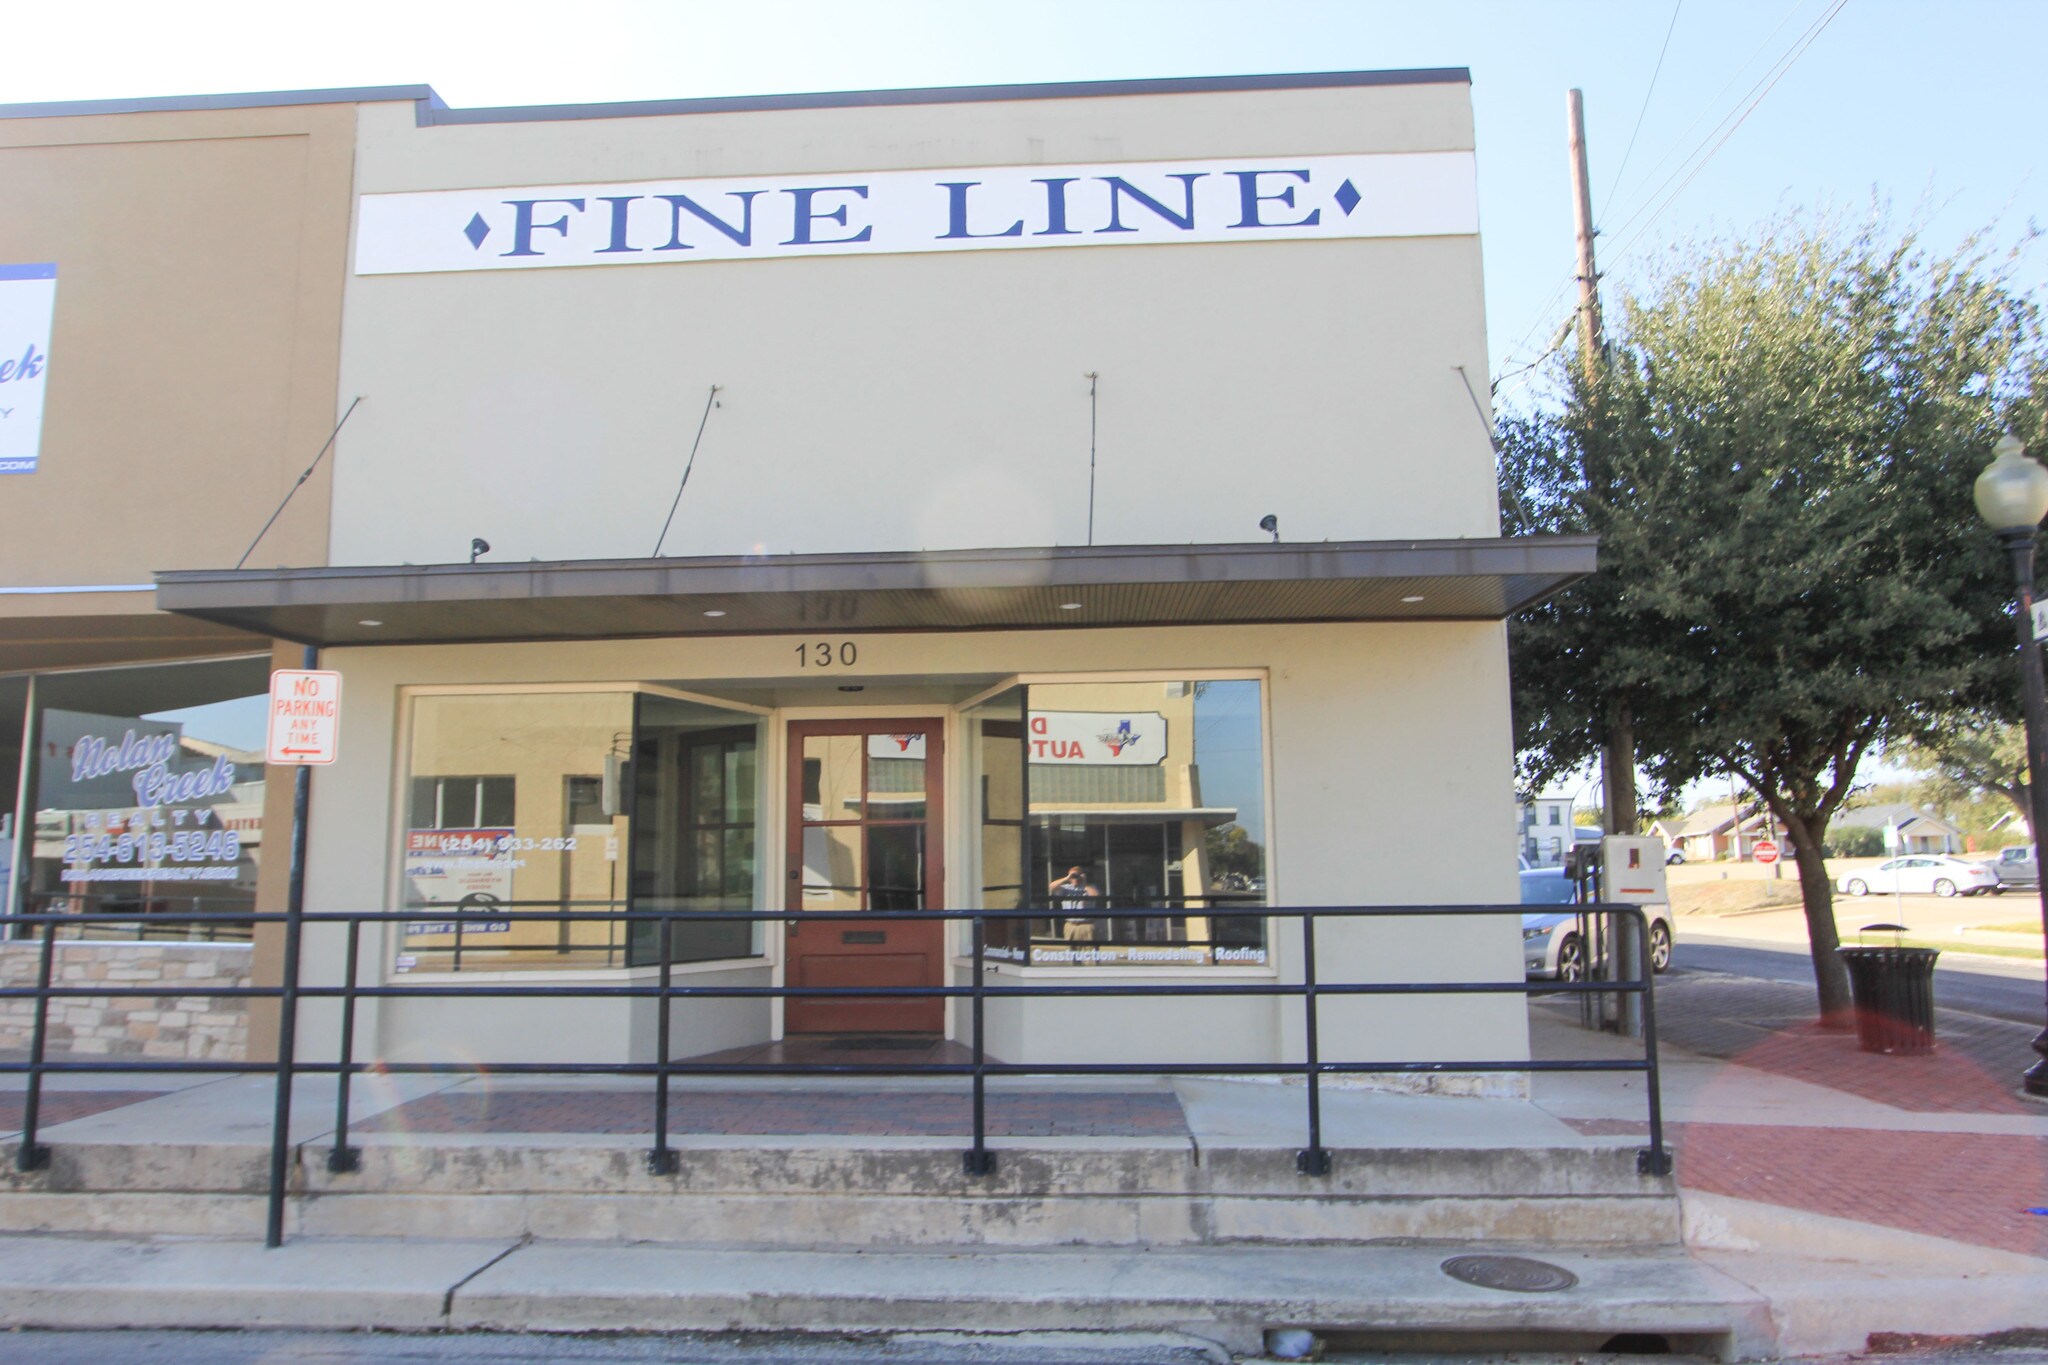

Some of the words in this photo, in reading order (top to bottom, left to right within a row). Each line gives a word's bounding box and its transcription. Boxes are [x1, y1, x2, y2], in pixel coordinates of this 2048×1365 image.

[499, 185, 873, 257] FINE
[935, 169, 1320, 239] LINE
[0, 344, 44, 383] ek
[0, 460, 36, 472] COM
[794, 641, 857, 667] 130
[294, 680, 319, 697] NO
[276, 699, 335, 718] PARKING
[291, 719, 318, 731] ANY
[287, 732, 320, 745] TIME
[71, 728, 176, 783] Nolan
[132, 752, 235, 808] Creek
[85, 809, 213, 829] REALTY
[1032, 948, 1116, 962] Construction
[1127, 947, 1204, 963] Remodeling
[1215, 947, 1265, 963] Roofing
